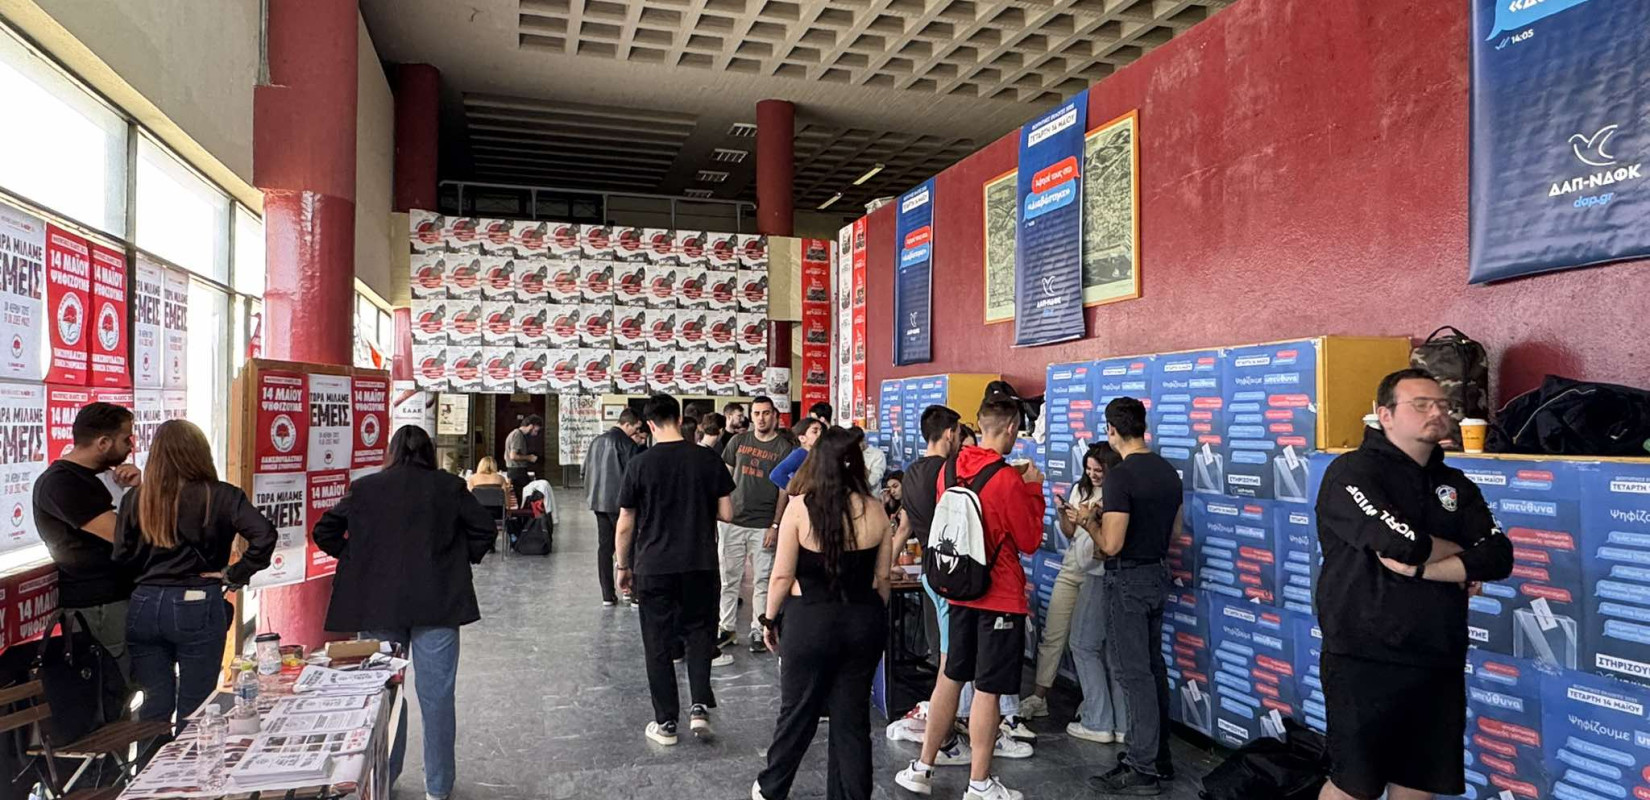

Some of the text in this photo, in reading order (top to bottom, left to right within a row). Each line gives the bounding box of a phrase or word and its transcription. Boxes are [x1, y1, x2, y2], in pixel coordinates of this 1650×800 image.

[1511, 29, 1534, 44] 14:05
[1549, 164, 1642, 196] ΔΑΠ-ΝΔΦΚ
[1574, 192, 1614, 208] dap.gr
[51, 249, 61, 269] 14
[263, 386, 302, 402] 14 ΜΑΪΟΥ
[310, 404, 350, 427] ΕΜΕΙΣ
[738, 444, 778, 461] SUPERDRY
[257, 491, 302, 504] ΤΩΡΑ ΜΙΛΑΜΕ
[312, 486, 320, 500] 14
[1502, 501, 1554, 514] υπεύθυνα
[1610, 509, 1650, 524] Ψηφίζο
[18, 599, 32, 622] 14
[1598, 656, 1650, 675] ΣΤΗΡΙΖΟΥ
[1570, 690, 1602, 703] ΤΕΤΑΡΤΗ
[1603, 698, 1612, 706] 14
[1614, 702, 1640, 712] ΜΑΪΟΥ
